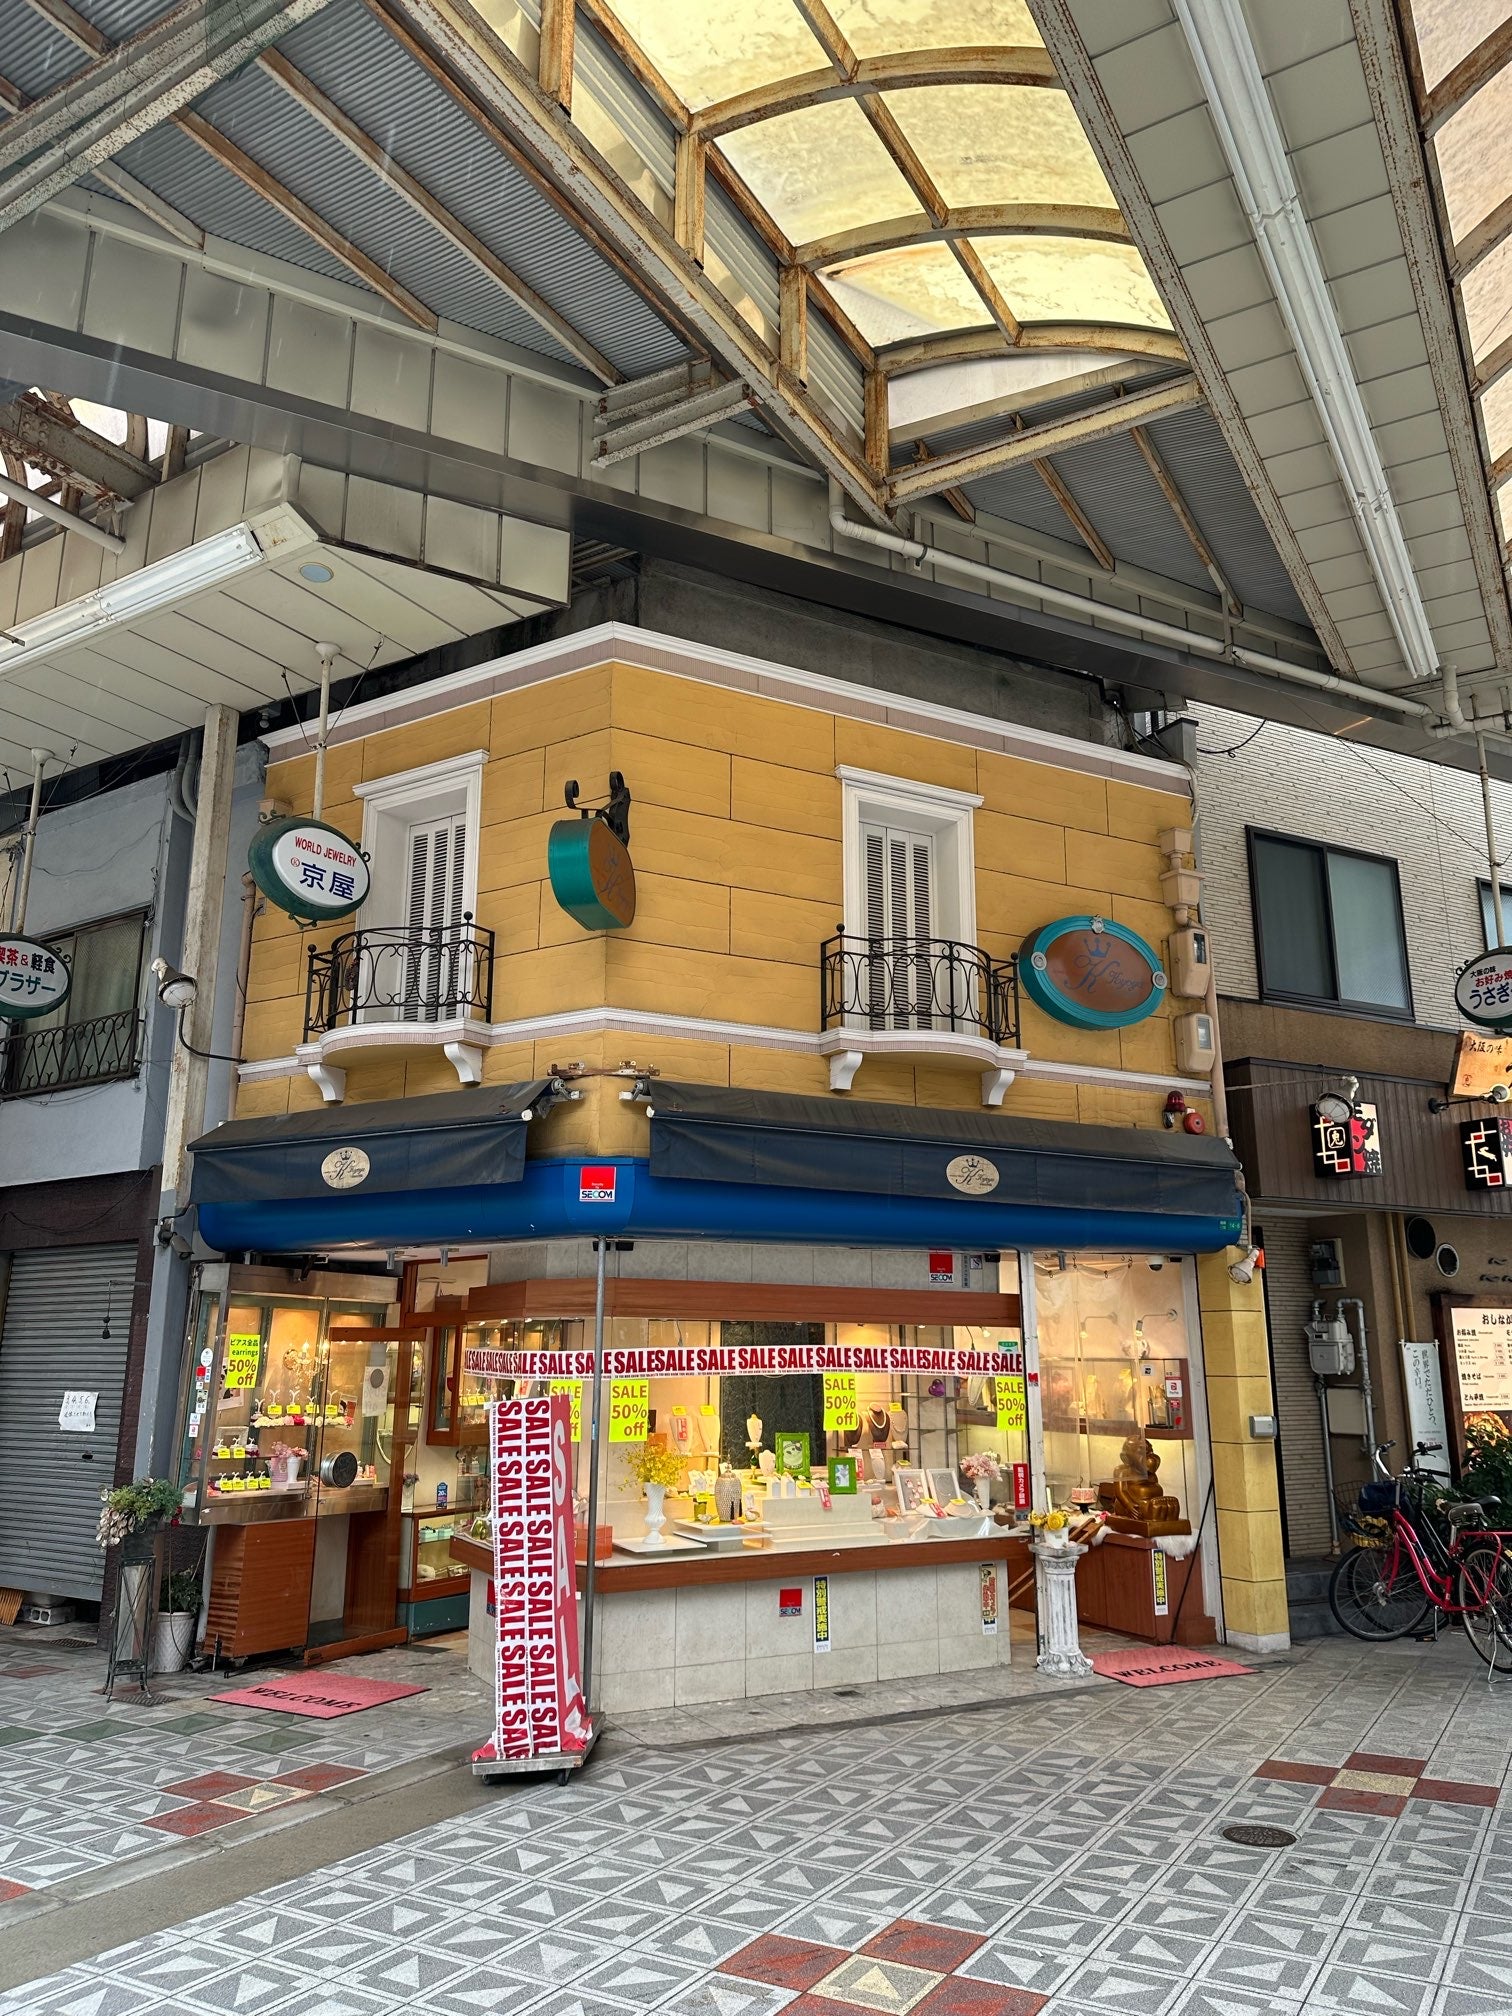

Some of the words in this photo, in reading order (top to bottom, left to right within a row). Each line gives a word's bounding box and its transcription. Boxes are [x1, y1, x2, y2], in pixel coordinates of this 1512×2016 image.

[295, 836, 322, 855] WORLD
[323, 847, 357, 867] JEWELRY
[300, 862, 355, 901] 京屋
[1469, 982, 1512, 1009] うさぎ
[581, 1190, 613, 1199] SECOM
[230, 1339, 258, 1347] ピアス全品
[232, 1349, 258, 1357] earrings
[228, 1359, 256, 1373] 50%
[514, 1352, 537, 1374] SALE
[538, 1353, 573, 1375] SALE
[575, 1352, 612, 1375] SAE
[614, 1351, 655, 1374] SALE
[655, 1350, 694, 1371] SALE
[697, 1349, 735, 1370] SALE
[738, 1348, 776, 1369] SALE
[778, 1347, 813, 1368] SALE
[816, 1347, 852, 1368] SALE
[854, 1347, 888, 1369] SALE
[890, 1348, 923, 1370] SALE
[921, 1349, 956, 1371] SALE
[957, 1350, 990, 1372] SALE
[991, 1352, 1022, 1373] SALE
[237, 1373, 254, 1386] off
[825, 1378, 856, 1390] SALE
[997, 1382, 1024, 1393] SALE
[612, 1385, 647, 1399] SALE
[825, 1395, 856, 1409] 50%
[612, 1403, 647, 1420] 50%
[998, 1398, 1025, 1411] 50%
[497, 1401, 523, 1458] SALE
[525, 1400, 550, 1457] SALE
[624, 1422, 645, 1436] off
[836, 1412, 854, 1425] off
[1008, 1414, 1024, 1426] off
[497, 1460, 523, 1518] SALE
[525, 1459, 551, 1517] SALE
[499, 1521, 525, 1579] SALE
[527, 1519, 552, 1578] SALE
[500, 1581, 526, 1641] SALE
[527, 1581, 553, 1640] SALE
[816, 1580, 828, 1640] 特別警戒実施中
[501, 1644, 526, 1707] SALE
[529, 1644, 557, 1705] SALE
[1112, 1659, 1223, 1678] WELCOME
[246, 1687, 363, 1709] WELCOME
